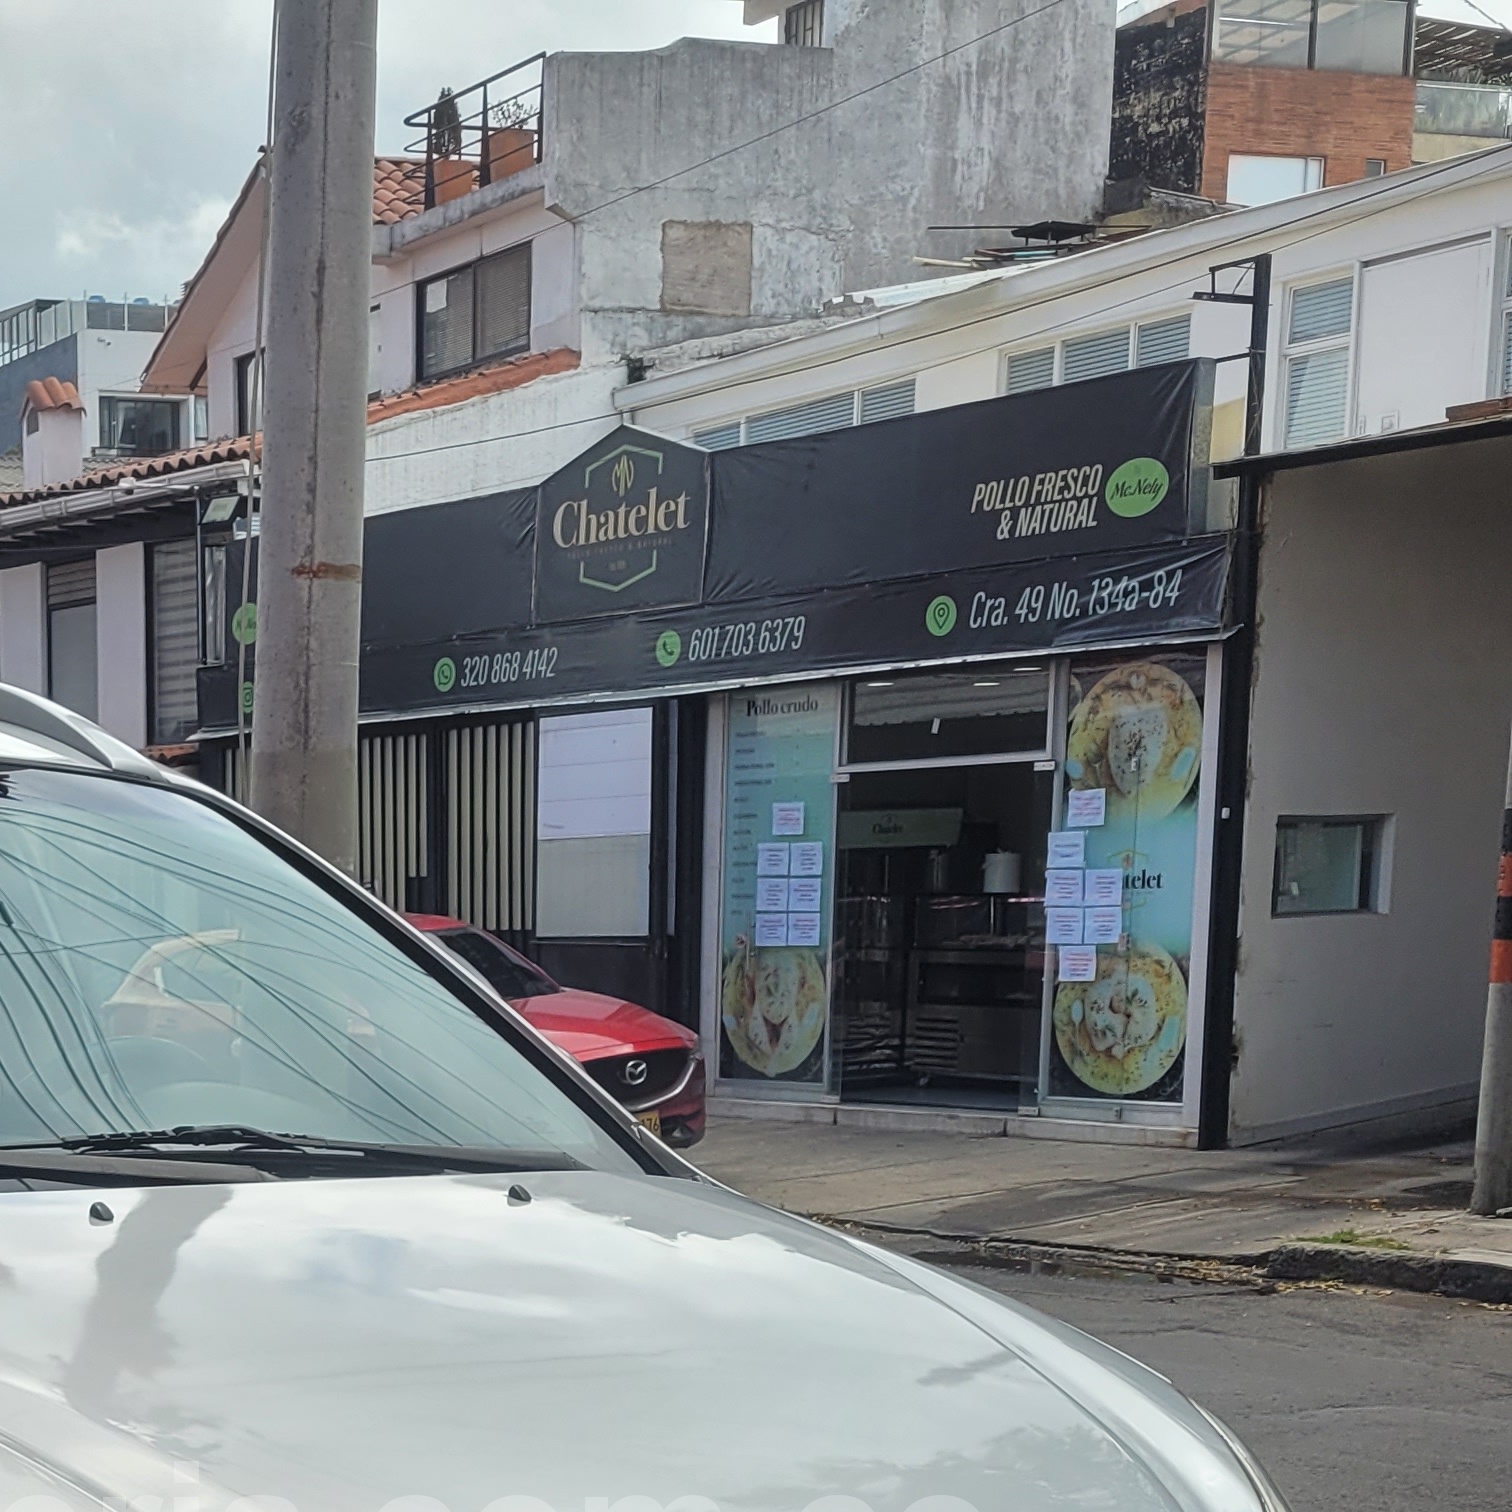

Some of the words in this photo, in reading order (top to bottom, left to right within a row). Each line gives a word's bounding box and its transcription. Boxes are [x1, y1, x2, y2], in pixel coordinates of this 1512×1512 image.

[971, 475, 1029, 514] POLLO
[1030, 463, 1103, 502] FRESCO
[552, 486, 691, 549] Chatelet
[996, 509, 1013, 540] &
[1014, 496, 1098, 538] NATURAL
[969, 591, 1008, 629] Cra.
[1014, 585, 1043, 623] 49
[1046, 580, 1081, 621] No.
[1088, 568, 1183, 616] 134a-84
[688, 626, 720, 661] 601
[721, 622, 756, 658] 703
[758, 615, 806, 654] 6379
[460, 655, 490, 687] 320
[491, 651, 521, 684] 868
[522, 646, 558, 680] 4142
[746, 699, 779, 717] Pollo
[780, 694, 819, 714] crudo
[1122, 869, 1163, 890] telet
